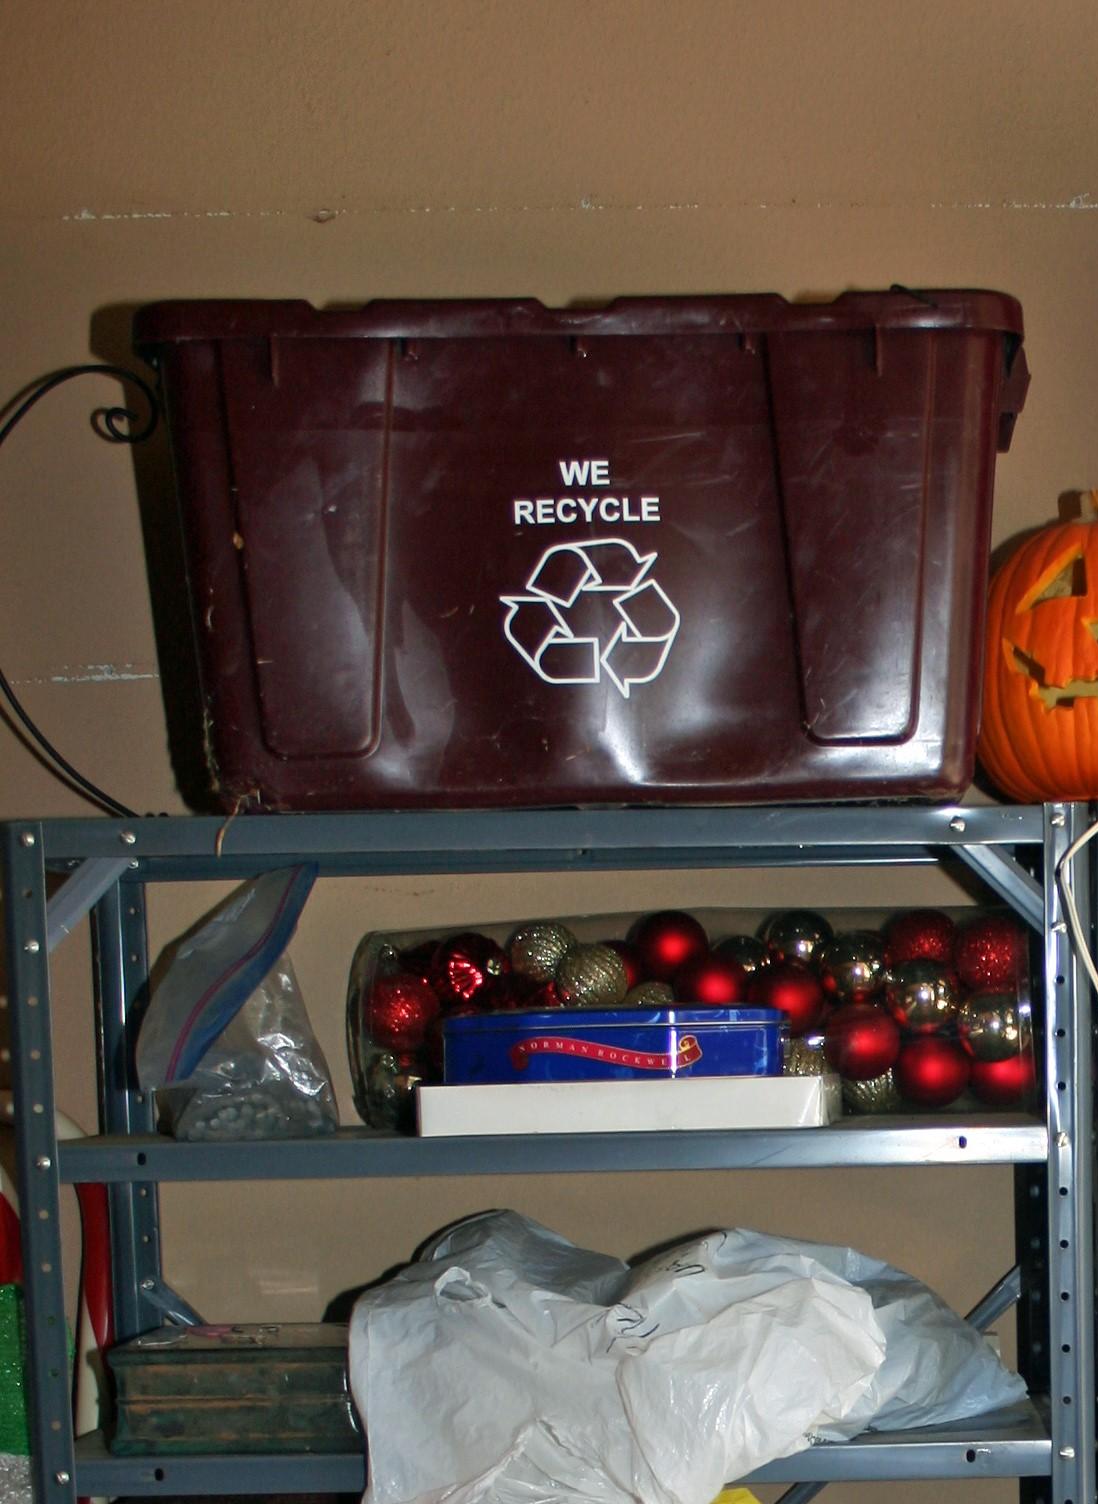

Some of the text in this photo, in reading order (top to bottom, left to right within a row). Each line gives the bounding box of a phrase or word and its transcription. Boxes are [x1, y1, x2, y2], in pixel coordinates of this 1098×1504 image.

[559, 460, 610, 486] WE
[513, 497, 661, 525] RECYCLE
[518, 1041, 692, 1066] NORMAN ROCKWEL
